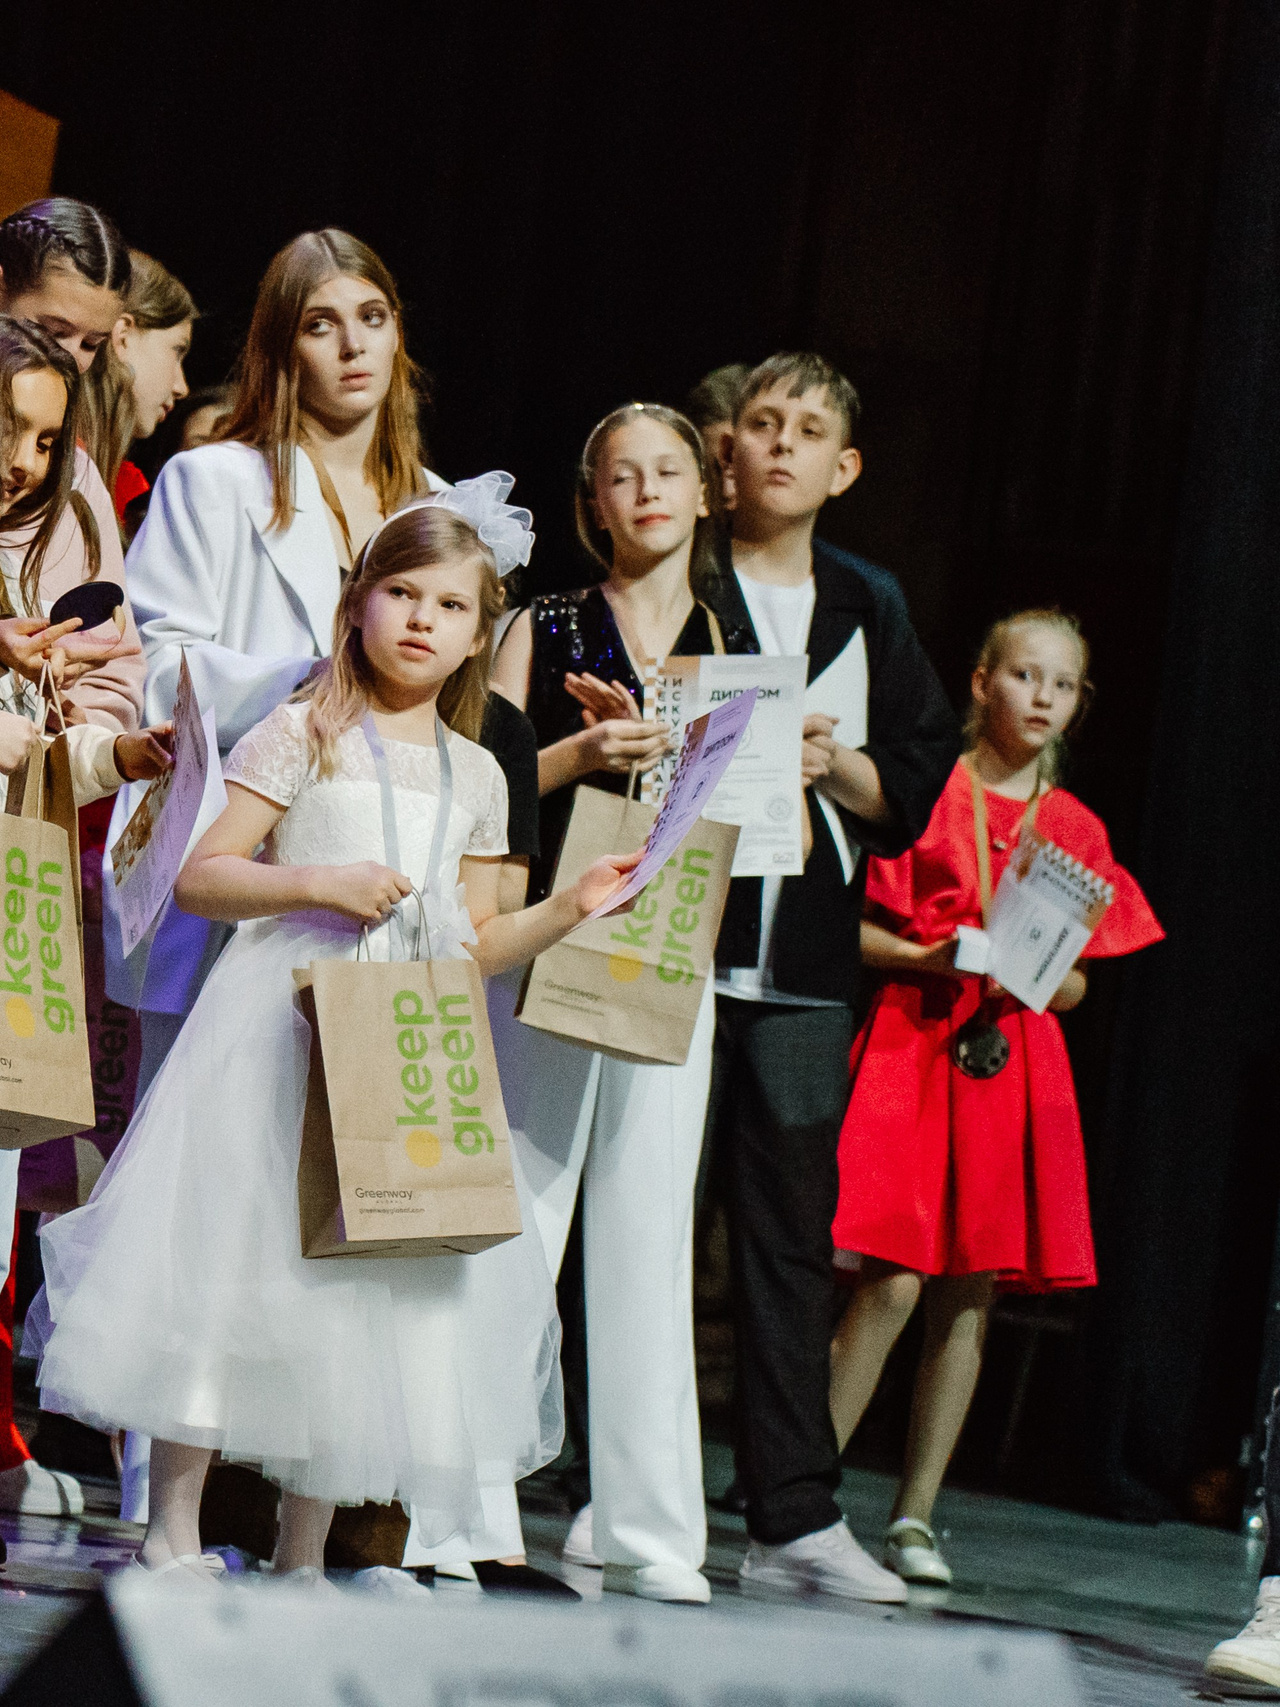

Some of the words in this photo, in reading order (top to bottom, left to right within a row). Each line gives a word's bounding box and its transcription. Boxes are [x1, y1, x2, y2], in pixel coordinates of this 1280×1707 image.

[709, 688, 780, 703] ДИПОМ
[37, 861, 75, 1035] green
[610, 857, 677, 948] kee
[656, 849, 714, 986] green
[392, 989, 438, 1126] keep
[437, 994, 495, 1156] green
[355, 1187, 413, 1201] Greenway
